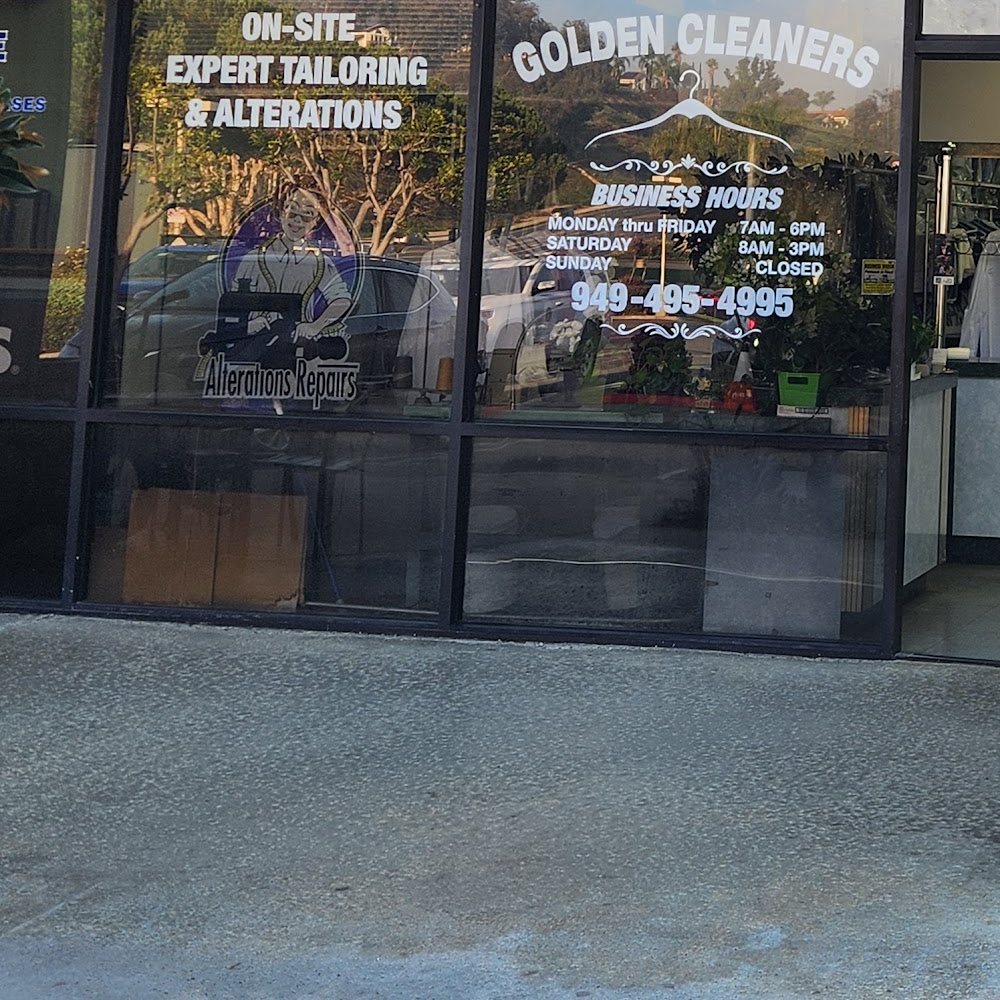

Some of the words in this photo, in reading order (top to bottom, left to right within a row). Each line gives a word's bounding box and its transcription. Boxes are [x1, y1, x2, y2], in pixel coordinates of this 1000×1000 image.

[242, 12, 356, 42] ON-SITE
[512, 14, 665, 83] GOLDEN
[677, 13, 880, 88] CLEANERS
[166, 55, 274, 84] EXPERT
[280, 55, 428, 86] TAILORING
[184, 98, 208, 128] &
[213, 98, 402, 130] ALTERATIONS
[591, 184, 702, 209] BUSINESS
[705, 186, 785, 210] HOURS
[548, 216, 619, 232] MONDAY
[622, 217, 653, 233] thru
[657, 218, 717, 235] FRIDAY
[739, 220, 775, 235] 7AM
[789, 221, 825, 237] 6PM
[546, 235, 633, 252] SATURDAY
[738, 240, 774, 256] 8AM
[788, 240, 824, 257] 3PM
[545, 255, 612, 271] SUNDAY
[755, 260, 824, 277] CLOSED
[571, 281, 795, 318] 949-495-4995
[204, 352, 293, 399] Alterations
[296, 358, 359, 410] Repairs
